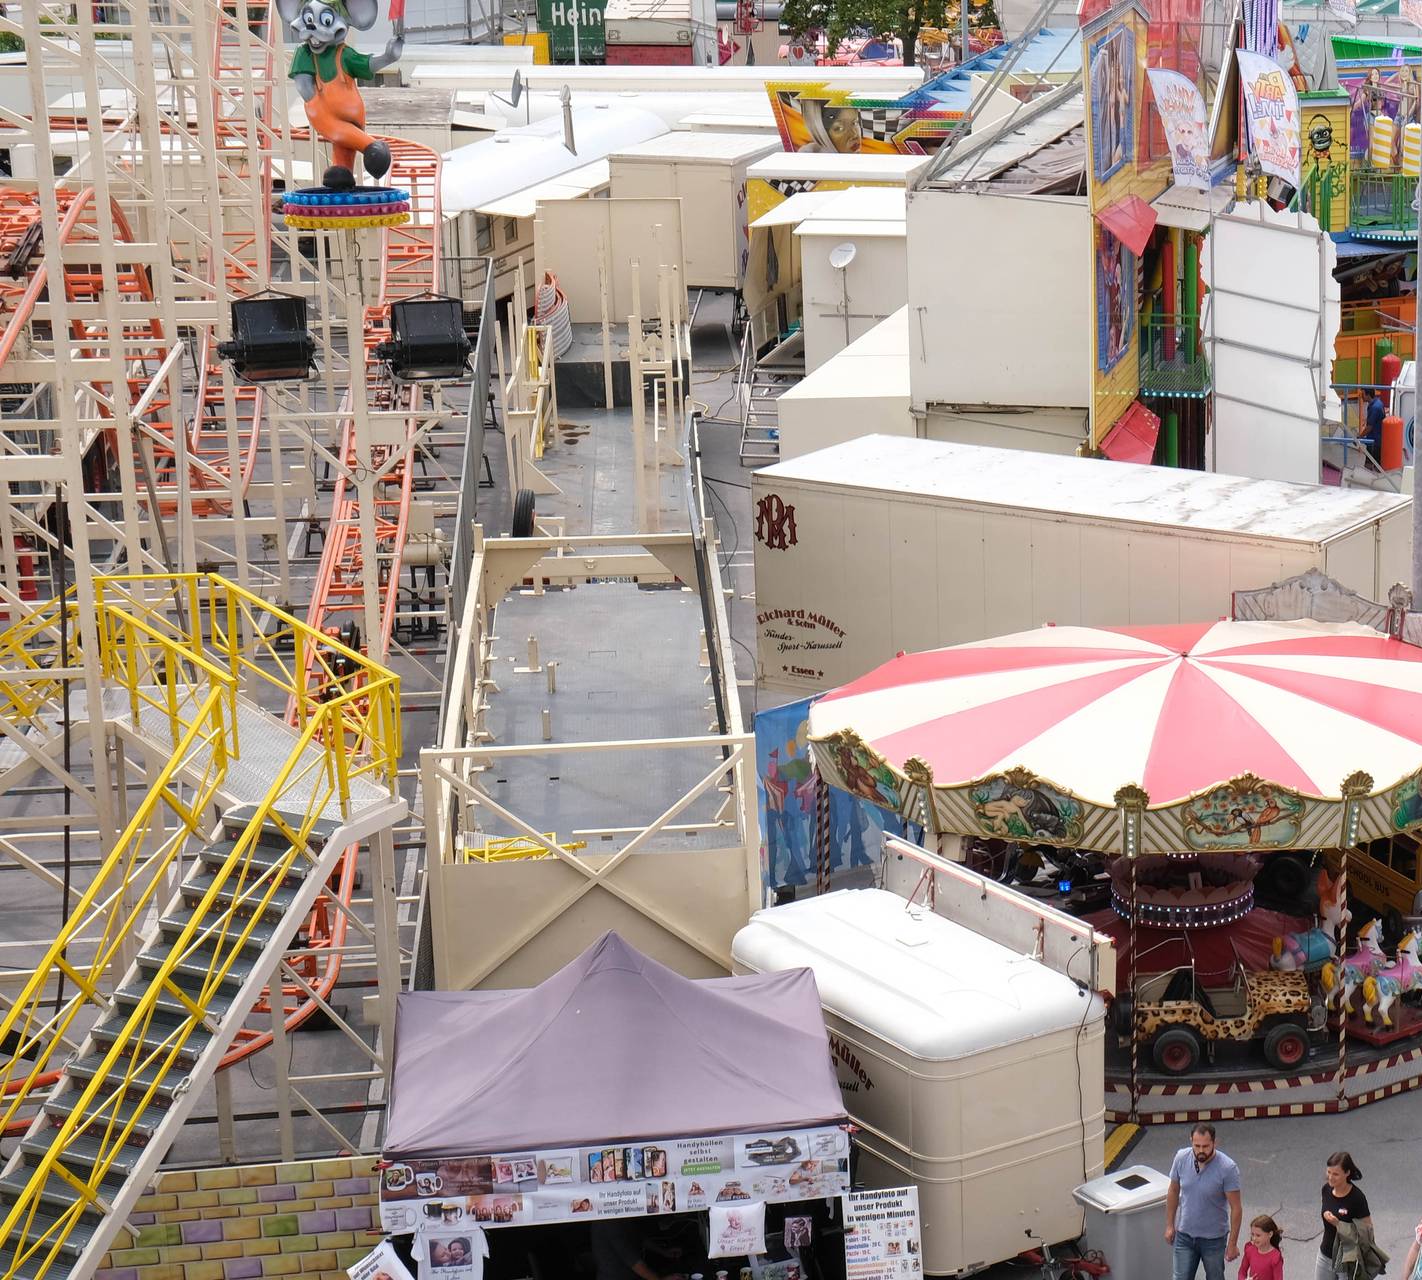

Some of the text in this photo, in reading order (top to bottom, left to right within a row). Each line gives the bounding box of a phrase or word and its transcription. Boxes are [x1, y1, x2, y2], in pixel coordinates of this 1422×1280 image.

[757, 608, 847, 638] Richard Müller
[786, 618, 816, 630] & Sohn
[777, 641, 843, 653] Sport-Karussell
[791, 666, 815, 676] Essen
[829, 1035, 875, 1091] Müller
[676, 1140, 724, 1149] Handyhüllen
[683, 1156, 718, 1165] gestalten
[607, 1189, 632, 1198] Handyfoto
[848, 1188, 908, 1202] Ihr Handyfoto auf
[618, 1198, 638, 1206] Produkt
[853, 1200, 903, 1211] unser Produkt
[624, 1205, 645, 1213] Minuten
[847, 1210, 915, 1223] in wenigen Minuten
